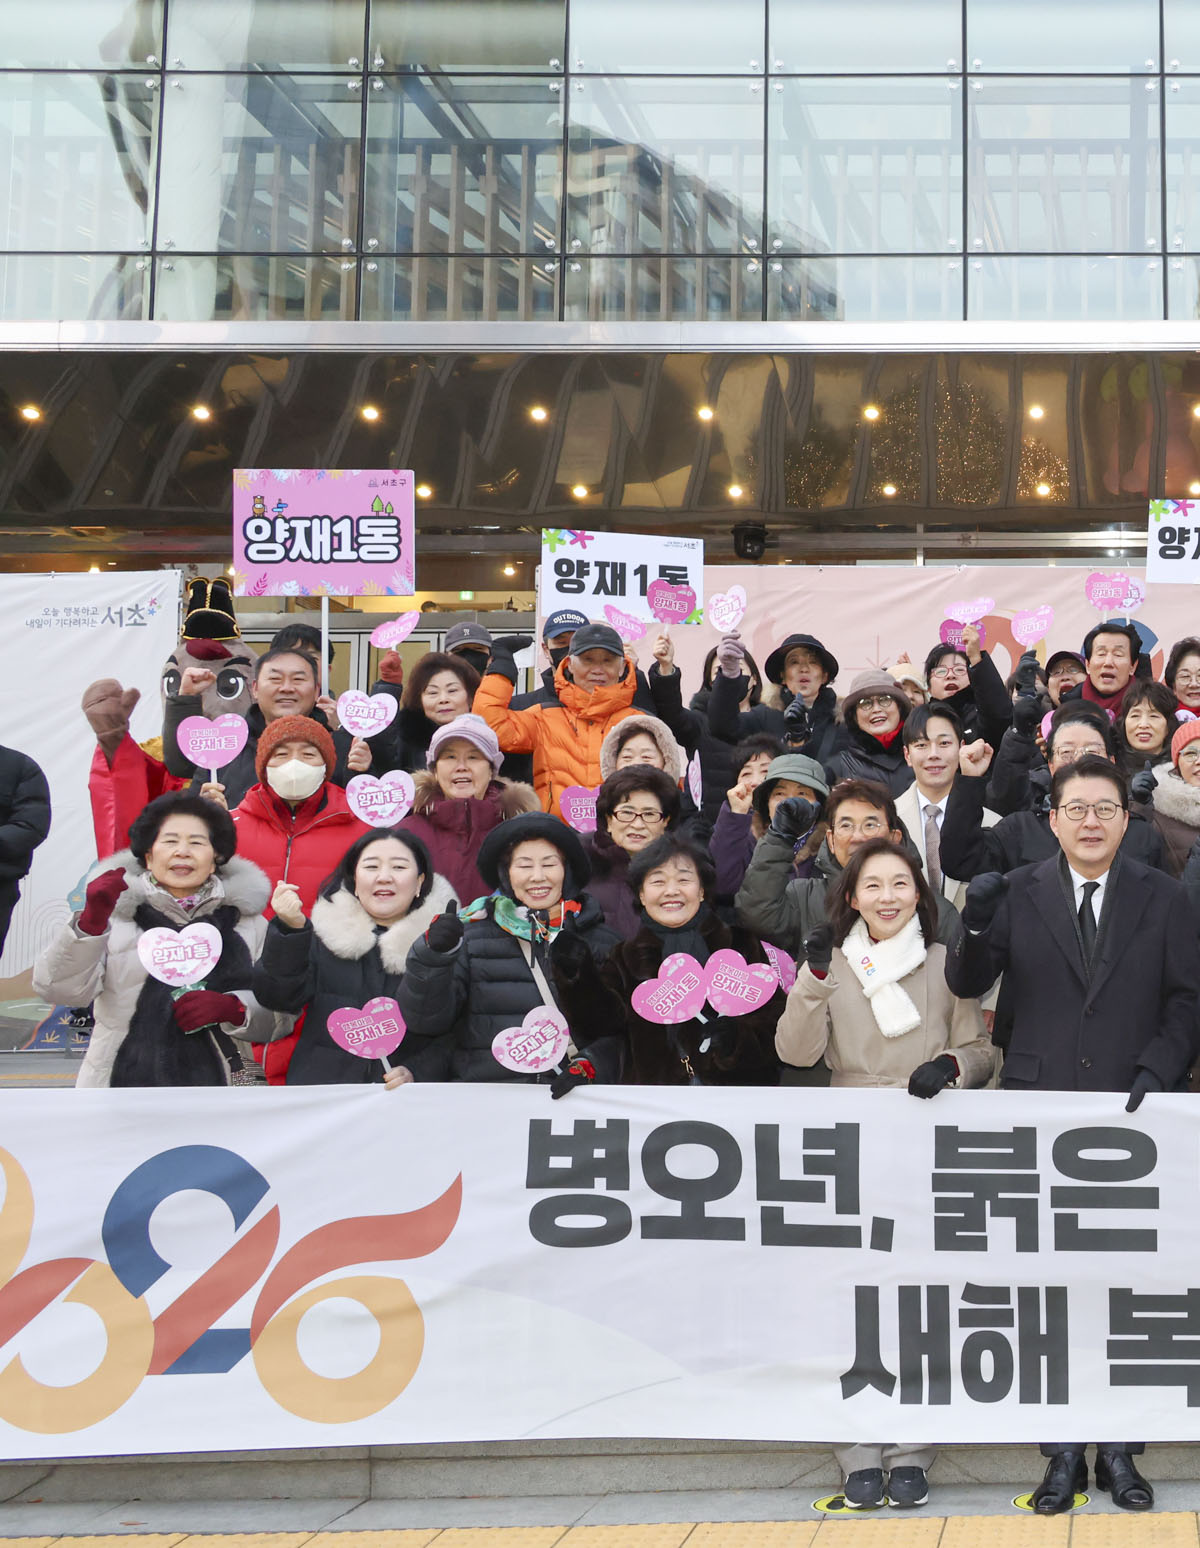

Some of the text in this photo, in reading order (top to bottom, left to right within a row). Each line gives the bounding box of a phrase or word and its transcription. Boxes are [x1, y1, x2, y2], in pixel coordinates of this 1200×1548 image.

[381, 479, 407, 487] 서초구
[243, 515, 402, 563] 양재1동
[42, 606, 99, 616] 오늘 행복하고
[101, 604, 147, 627] 서초
[654, 597, 688, 613] 양재1동
[25, 618, 98, 629] 내일이 기다려지는
[553, 613, 586, 624] OUTDOOR
[345, 704, 388, 720] 양재1동
[189, 735, 238, 752] 양재1동
[357, 788, 405, 808] 양재1동
[570, 805, 597, 820] 양재
[152, 943, 211, 965] 양재1동
[653, 971, 700, 1016] 양재1동
[711, 971, 762, 1004] 양재1동
[345, 1018, 399, 1046] 양재1동
[508, 1022, 560, 1063] 양재1동
[526, 1119, 895, 1252] 병오년,
[932, 1126, 1160, 1253] 붉은
[0, 1145, 463, 1434] 026
[840, 1282, 1069, 1406] 새해
